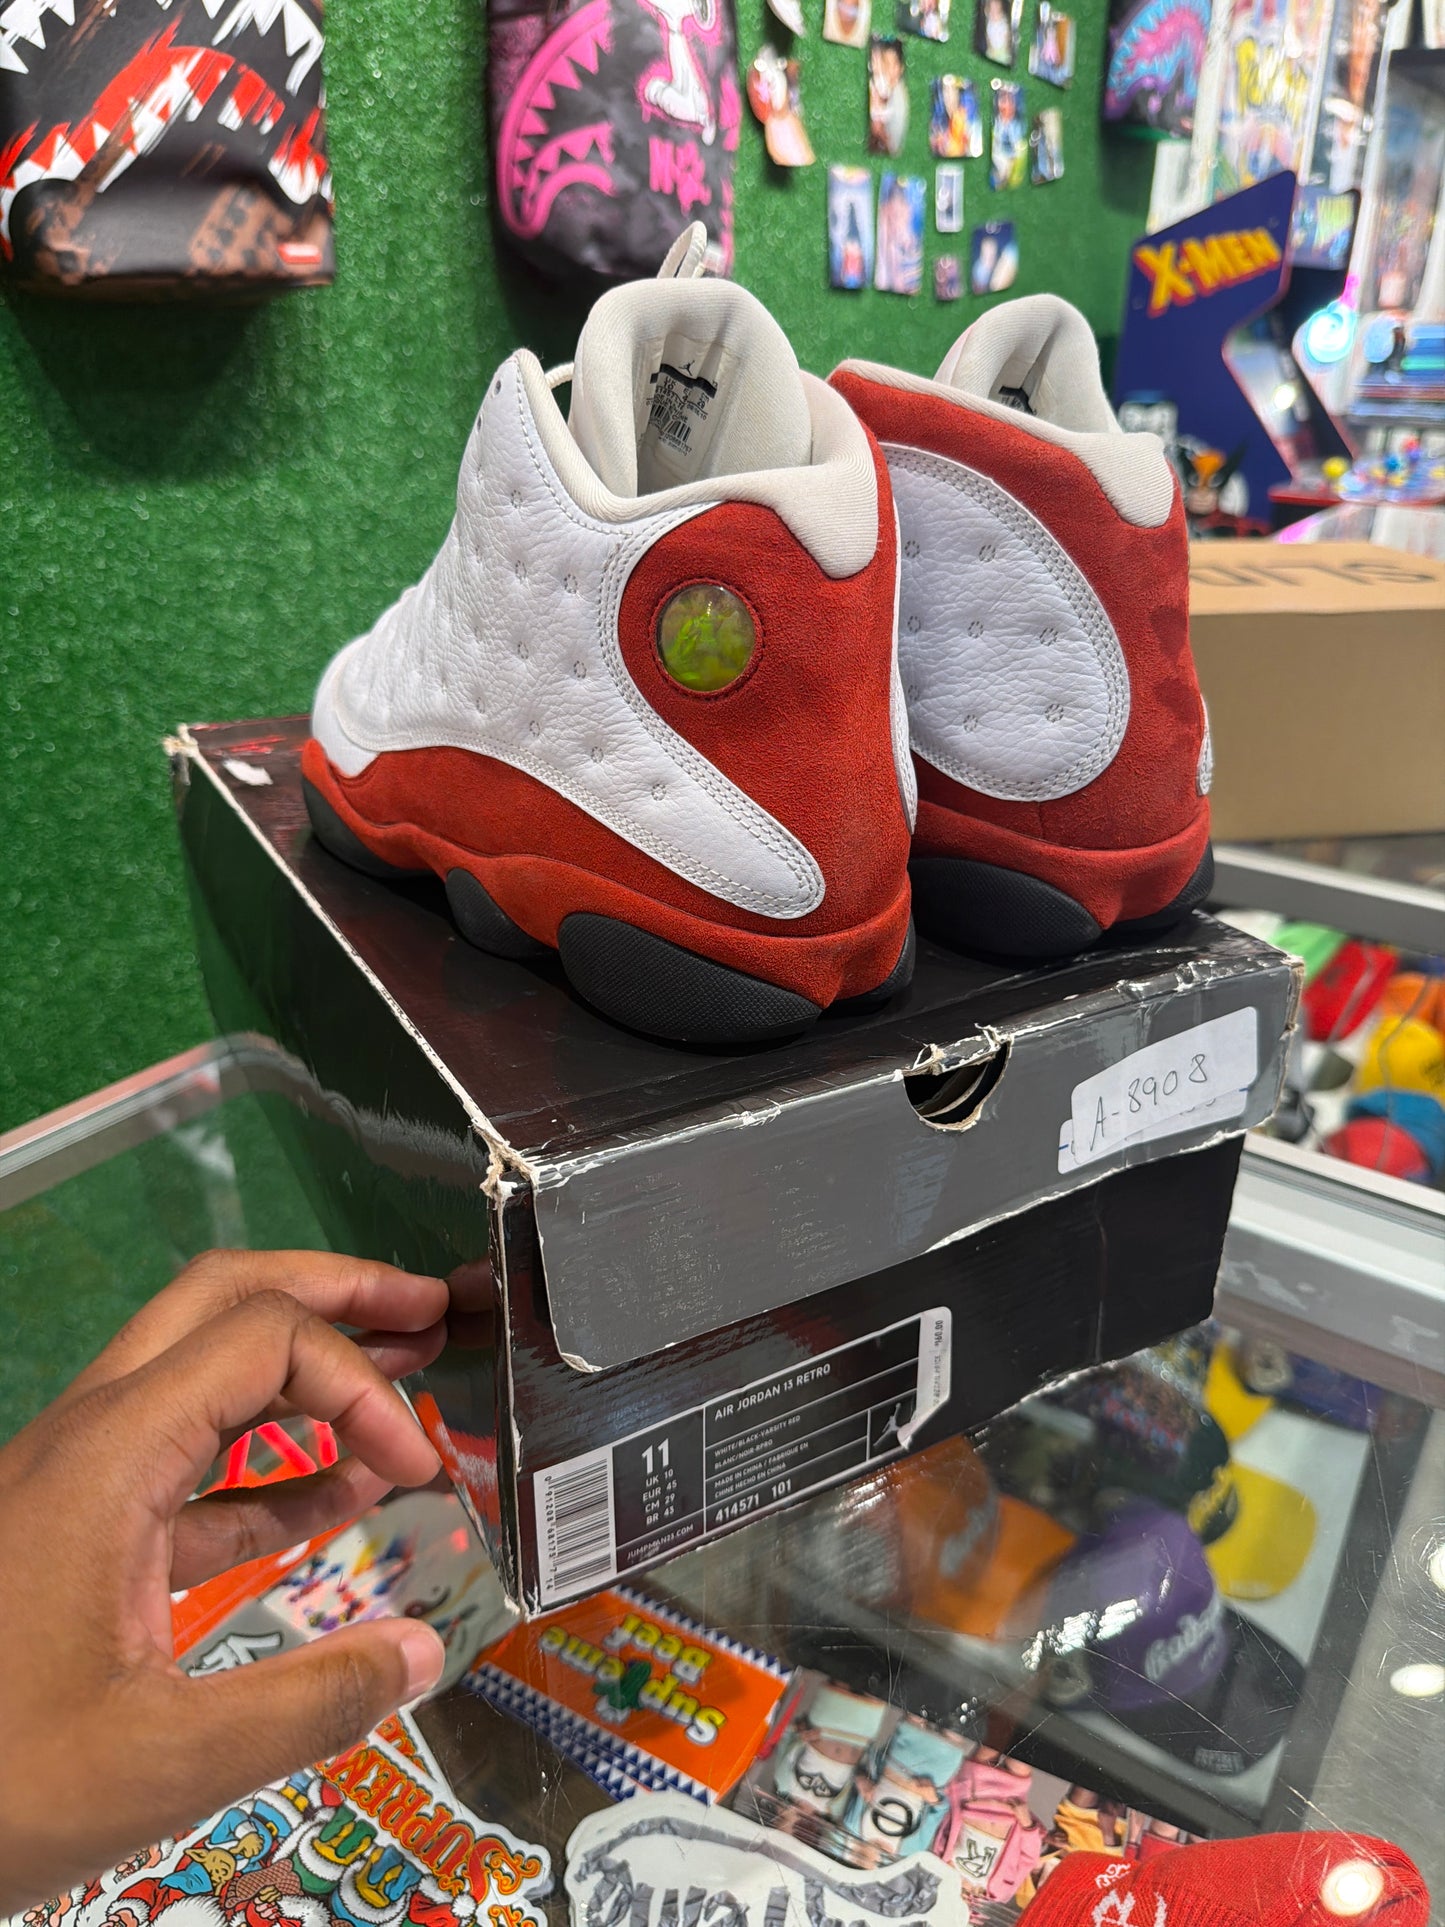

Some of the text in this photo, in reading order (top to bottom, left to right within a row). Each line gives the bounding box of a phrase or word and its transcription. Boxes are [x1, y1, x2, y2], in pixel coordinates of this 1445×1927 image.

[1133, 226, 1282, 319] X-MEN
[1089, 1053, 1208, 1152] A-8908
[715, 1363, 831, 1421] AIR JORDAN 13 RETRO
[788, 1415, 800, 1425] RED
[642, 1438, 669, 1474] 11
[714, 1474, 733, 1488] MADE
[734, 1470, 742, 1478] IN
[743, 1462, 762, 1475] CHINA
[768, 1445, 799, 1464] FABRIQUE
[799, 1442, 809, 1451] EN
[642, 1480, 677, 1502] EUR 45
[645, 1469, 674, 1487] UK 10
[714, 1462, 786, 1498] CHINE HECHO EN CHINA
[545, 1490, 554, 1522] 91208
[645, 1493, 675, 1513] CM 29
[715, 1479, 791, 1521] 414571 101
[646, 1513, 659, 1526] BR
[547, 1528, 556, 1559] 68175
[627, 1524, 694, 1560] JUMPMAN23.COM
[603, 1613, 713, 1684] Beer
[539, 1625, 727, 1746] Supeme
[313, 1740, 542, 1904] SUPREM
